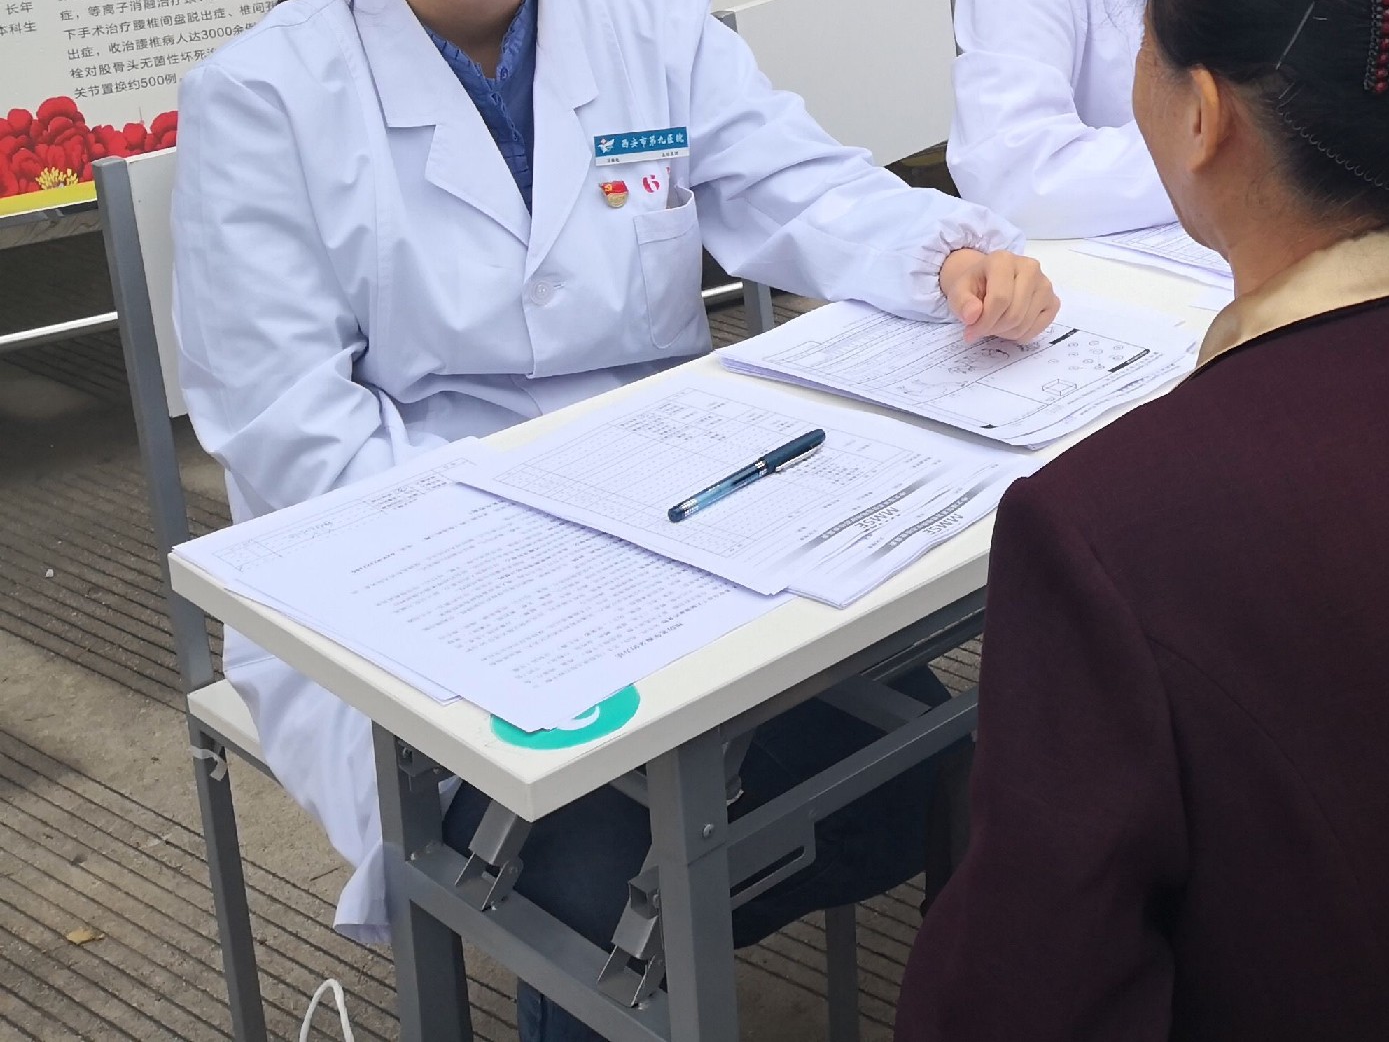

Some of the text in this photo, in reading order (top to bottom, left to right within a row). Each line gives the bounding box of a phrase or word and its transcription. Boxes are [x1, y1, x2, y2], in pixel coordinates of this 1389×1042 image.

[621, 133, 685, 149] 西安市第九医院
